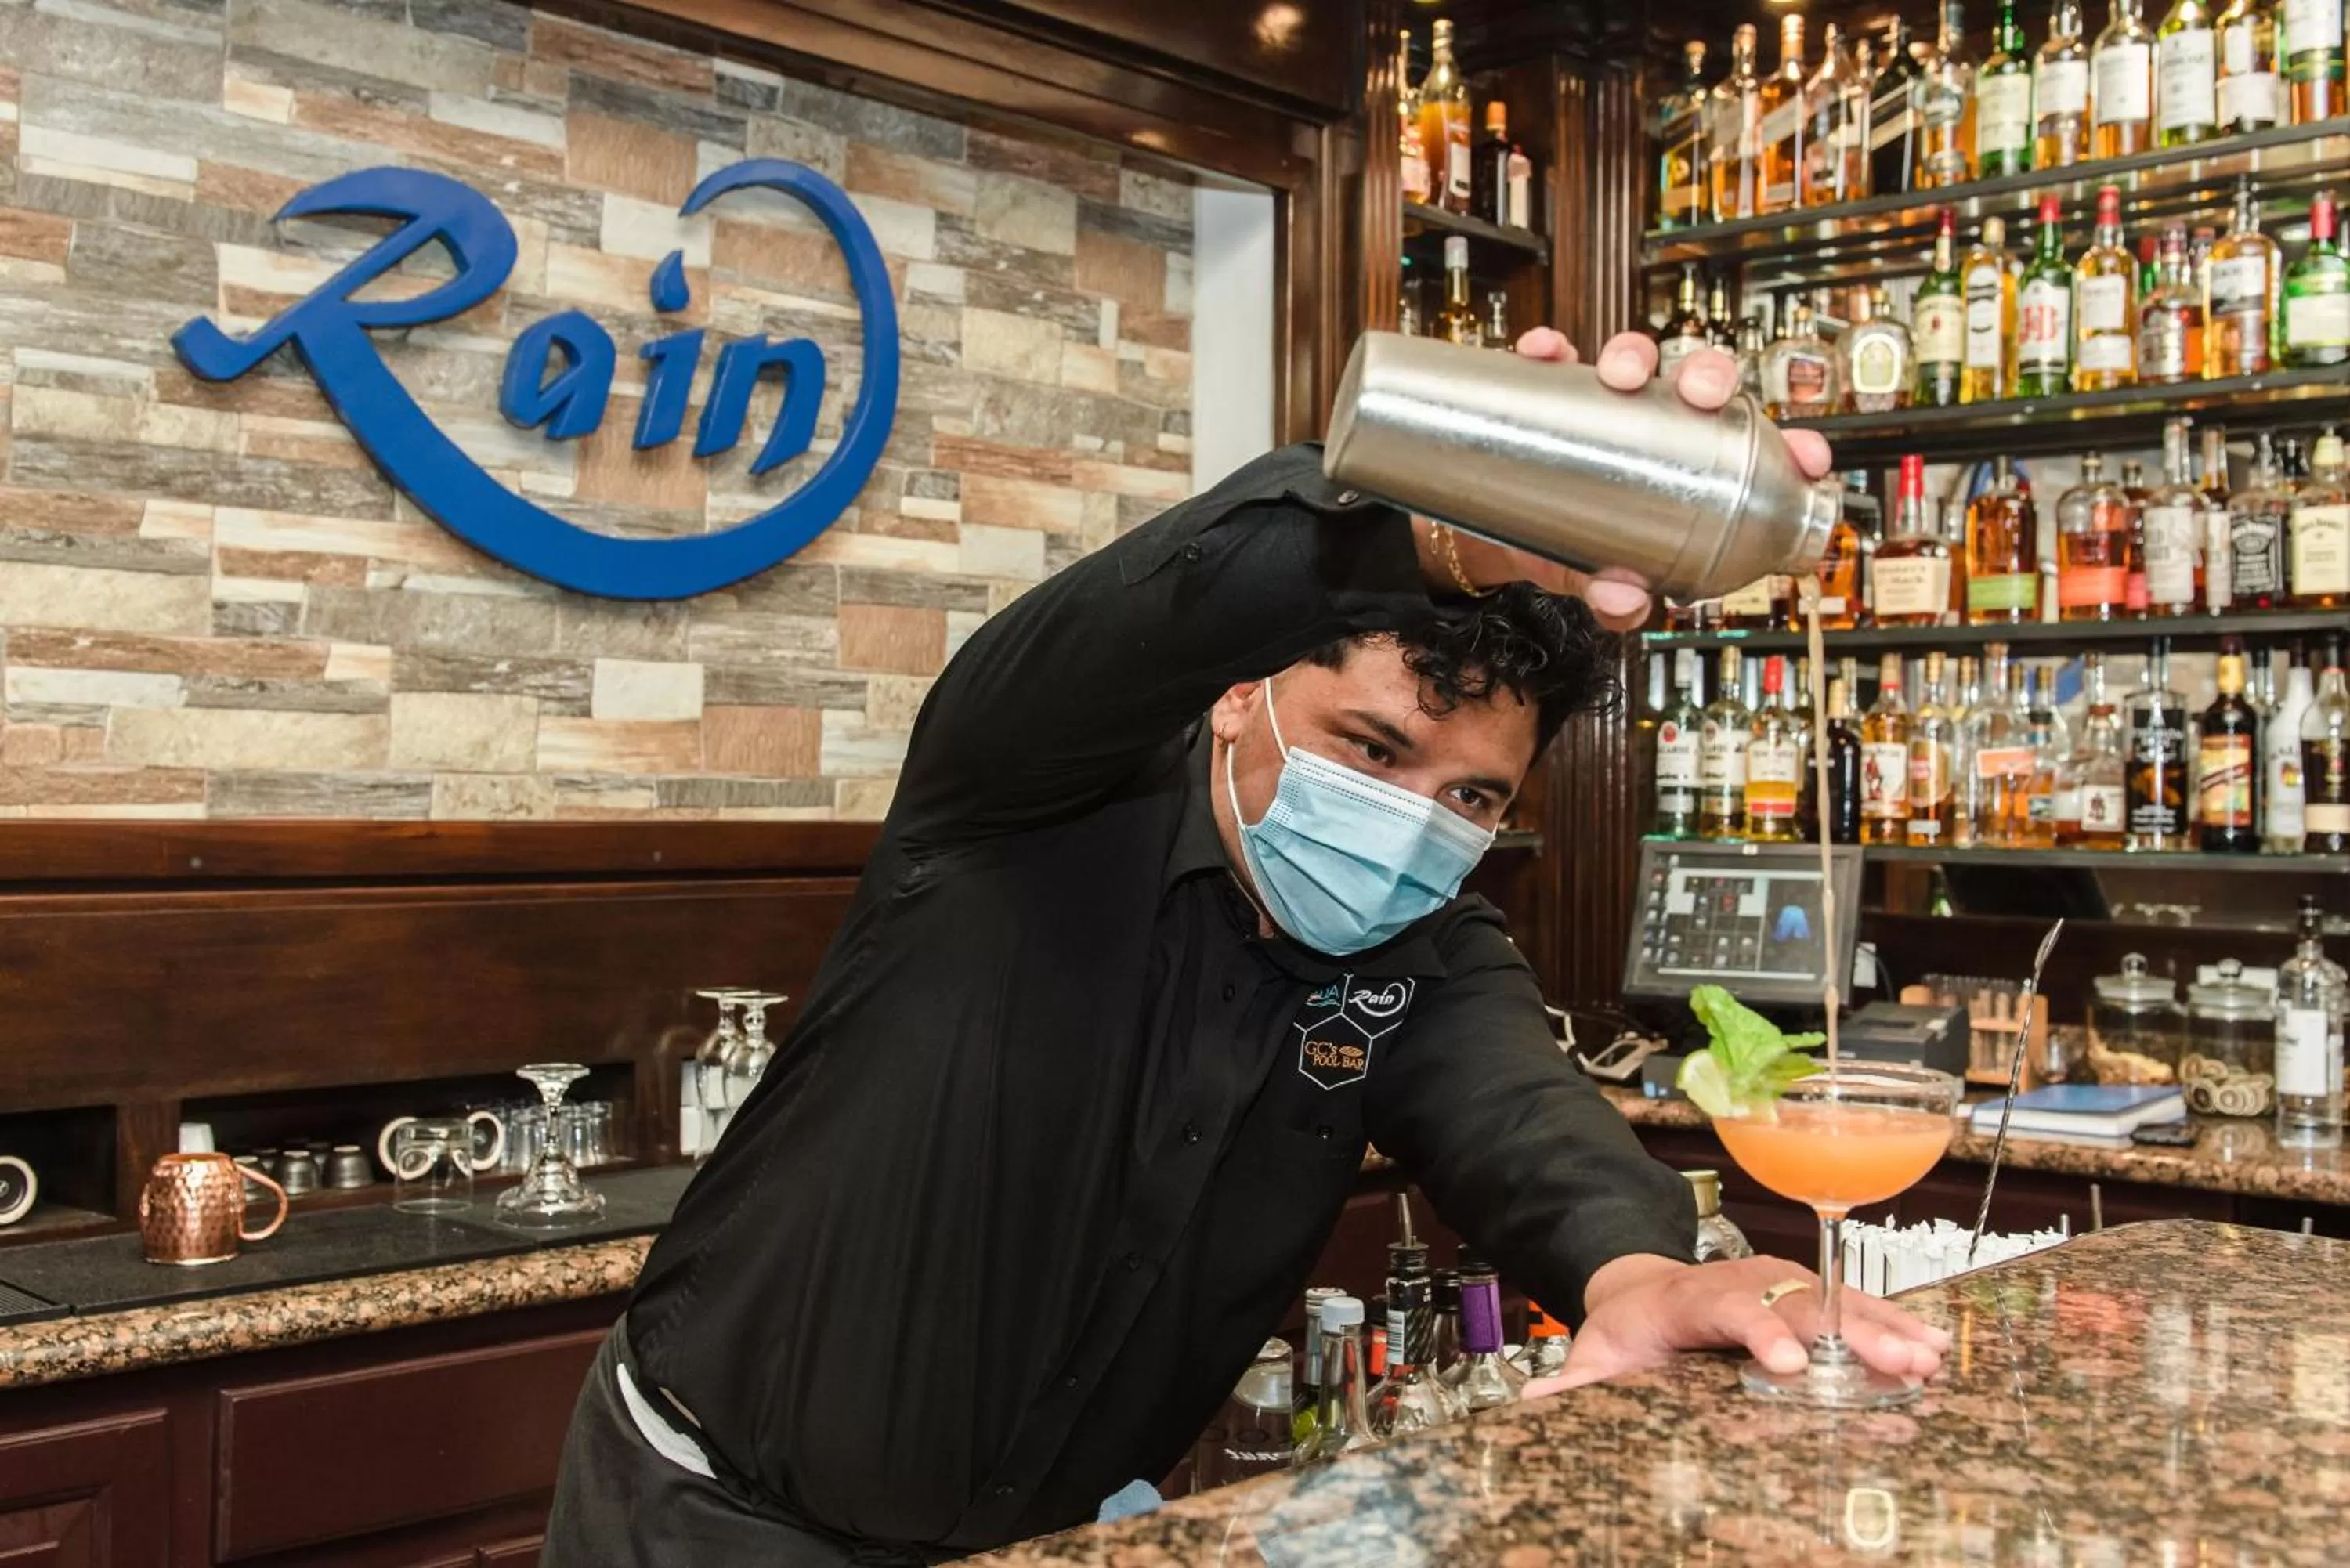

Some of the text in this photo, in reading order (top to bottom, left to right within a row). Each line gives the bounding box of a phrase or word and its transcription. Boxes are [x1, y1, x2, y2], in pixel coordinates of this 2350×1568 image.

[169, 158, 900, 601] Rain
[1348, 982, 1406, 1017] Rain
[1304, 1041, 1338, 1056] GC's
[1312, 1053, 1341, 1067] POOL
